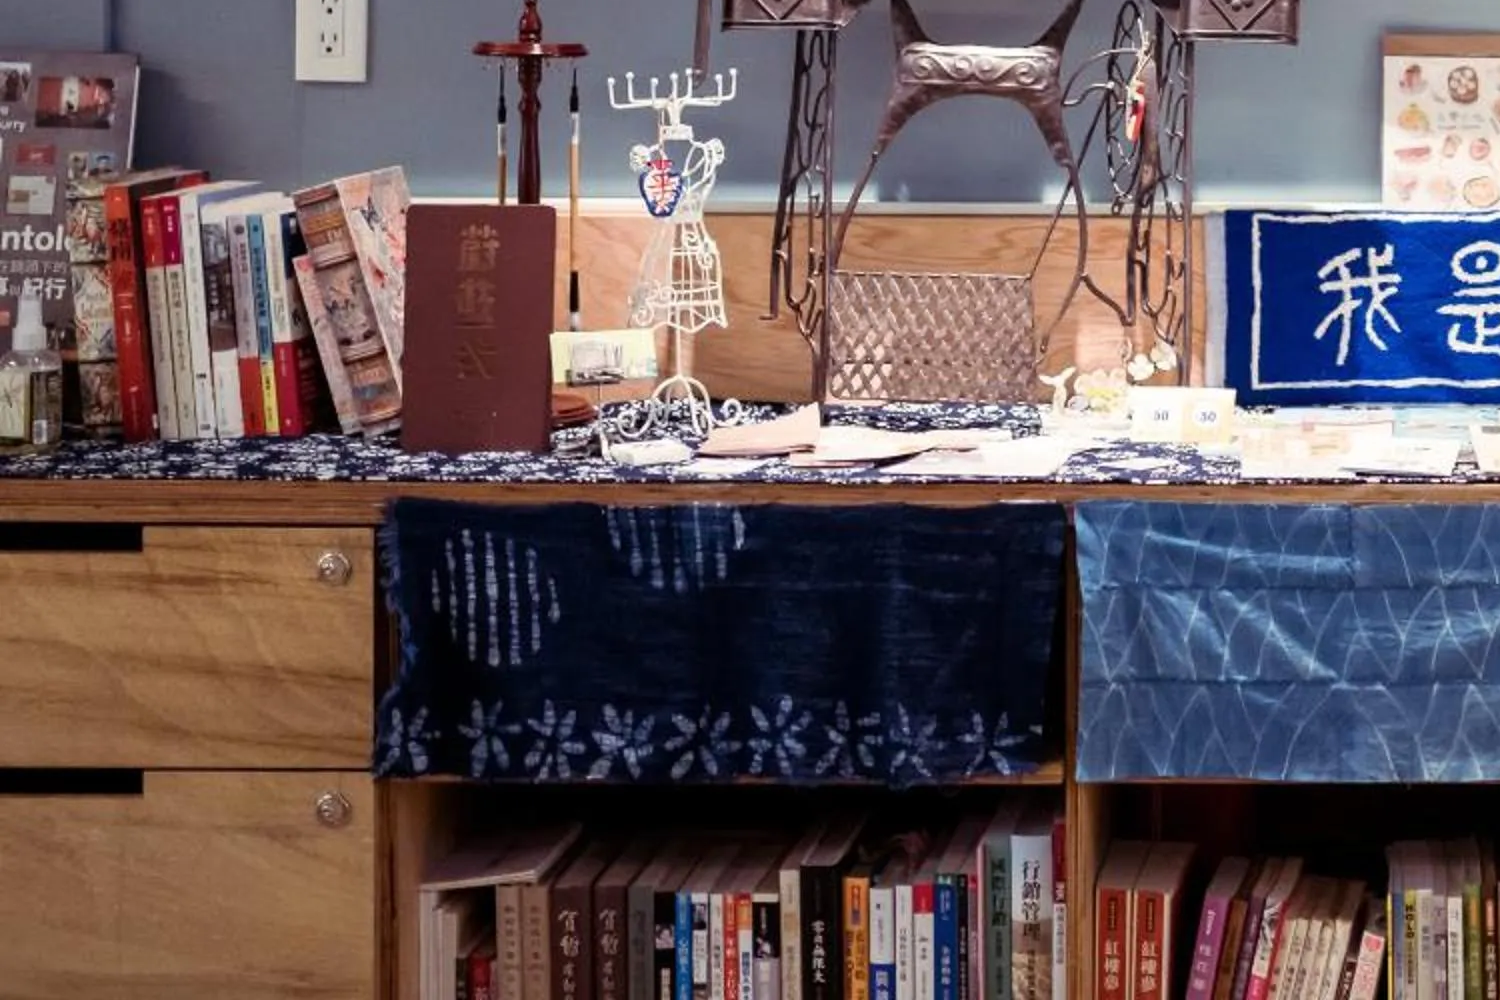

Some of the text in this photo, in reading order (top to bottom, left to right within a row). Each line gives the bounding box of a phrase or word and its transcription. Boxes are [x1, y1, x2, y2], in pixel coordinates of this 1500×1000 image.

[1021, 859, 1042, 941] 行銷管理
[1103, 940, 1121, 991] 紅樓夢
[1141, 940, 1158, 993] 紅樓夢
